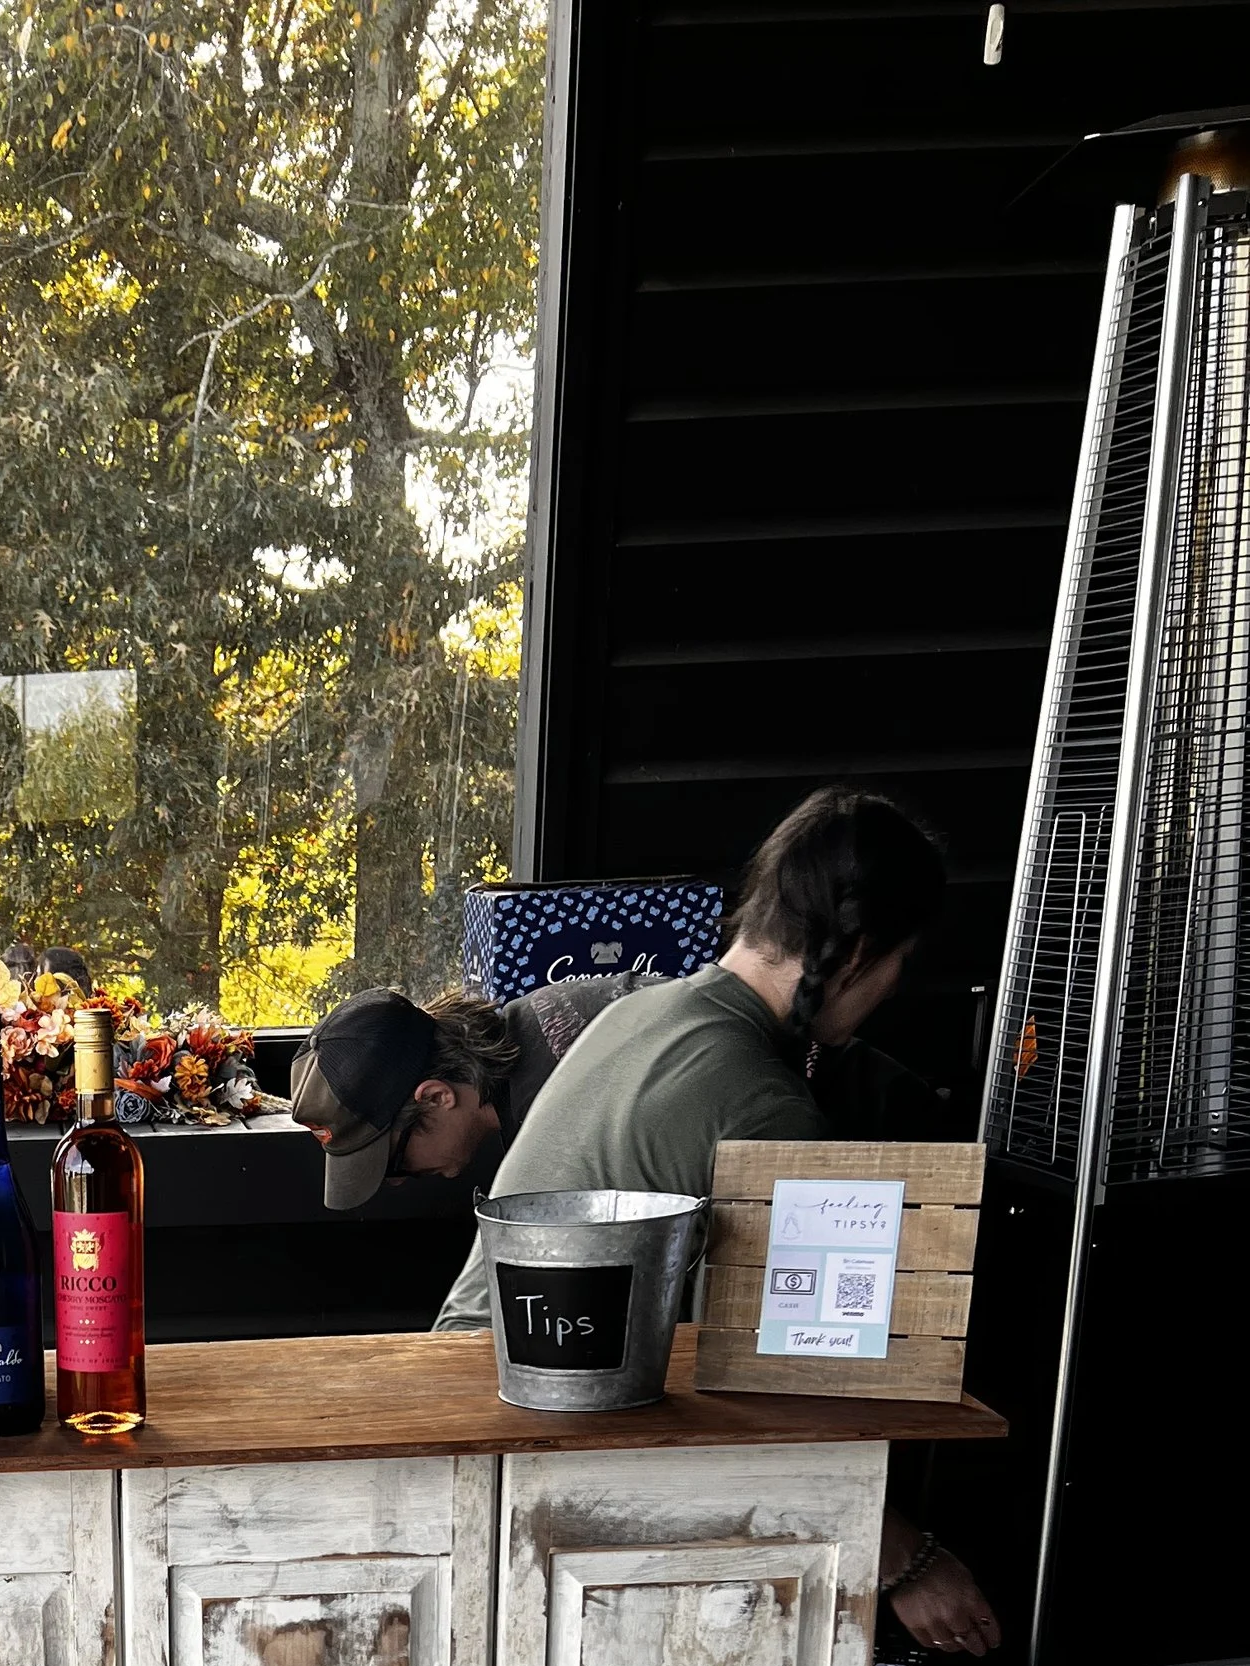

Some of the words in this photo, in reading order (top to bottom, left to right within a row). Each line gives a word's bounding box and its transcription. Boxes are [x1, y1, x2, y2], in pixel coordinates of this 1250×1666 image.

[794, 1196, 888, 1219] feeling
[834, 1219, 887, 1230] TIPSY?
[60, 1275, 118, 1292] RICCO
[515, 1294, 595, 1347] Tips
[791, 1332, 826, 1345] Thank
[829, 1334, 854, 1346] you!
